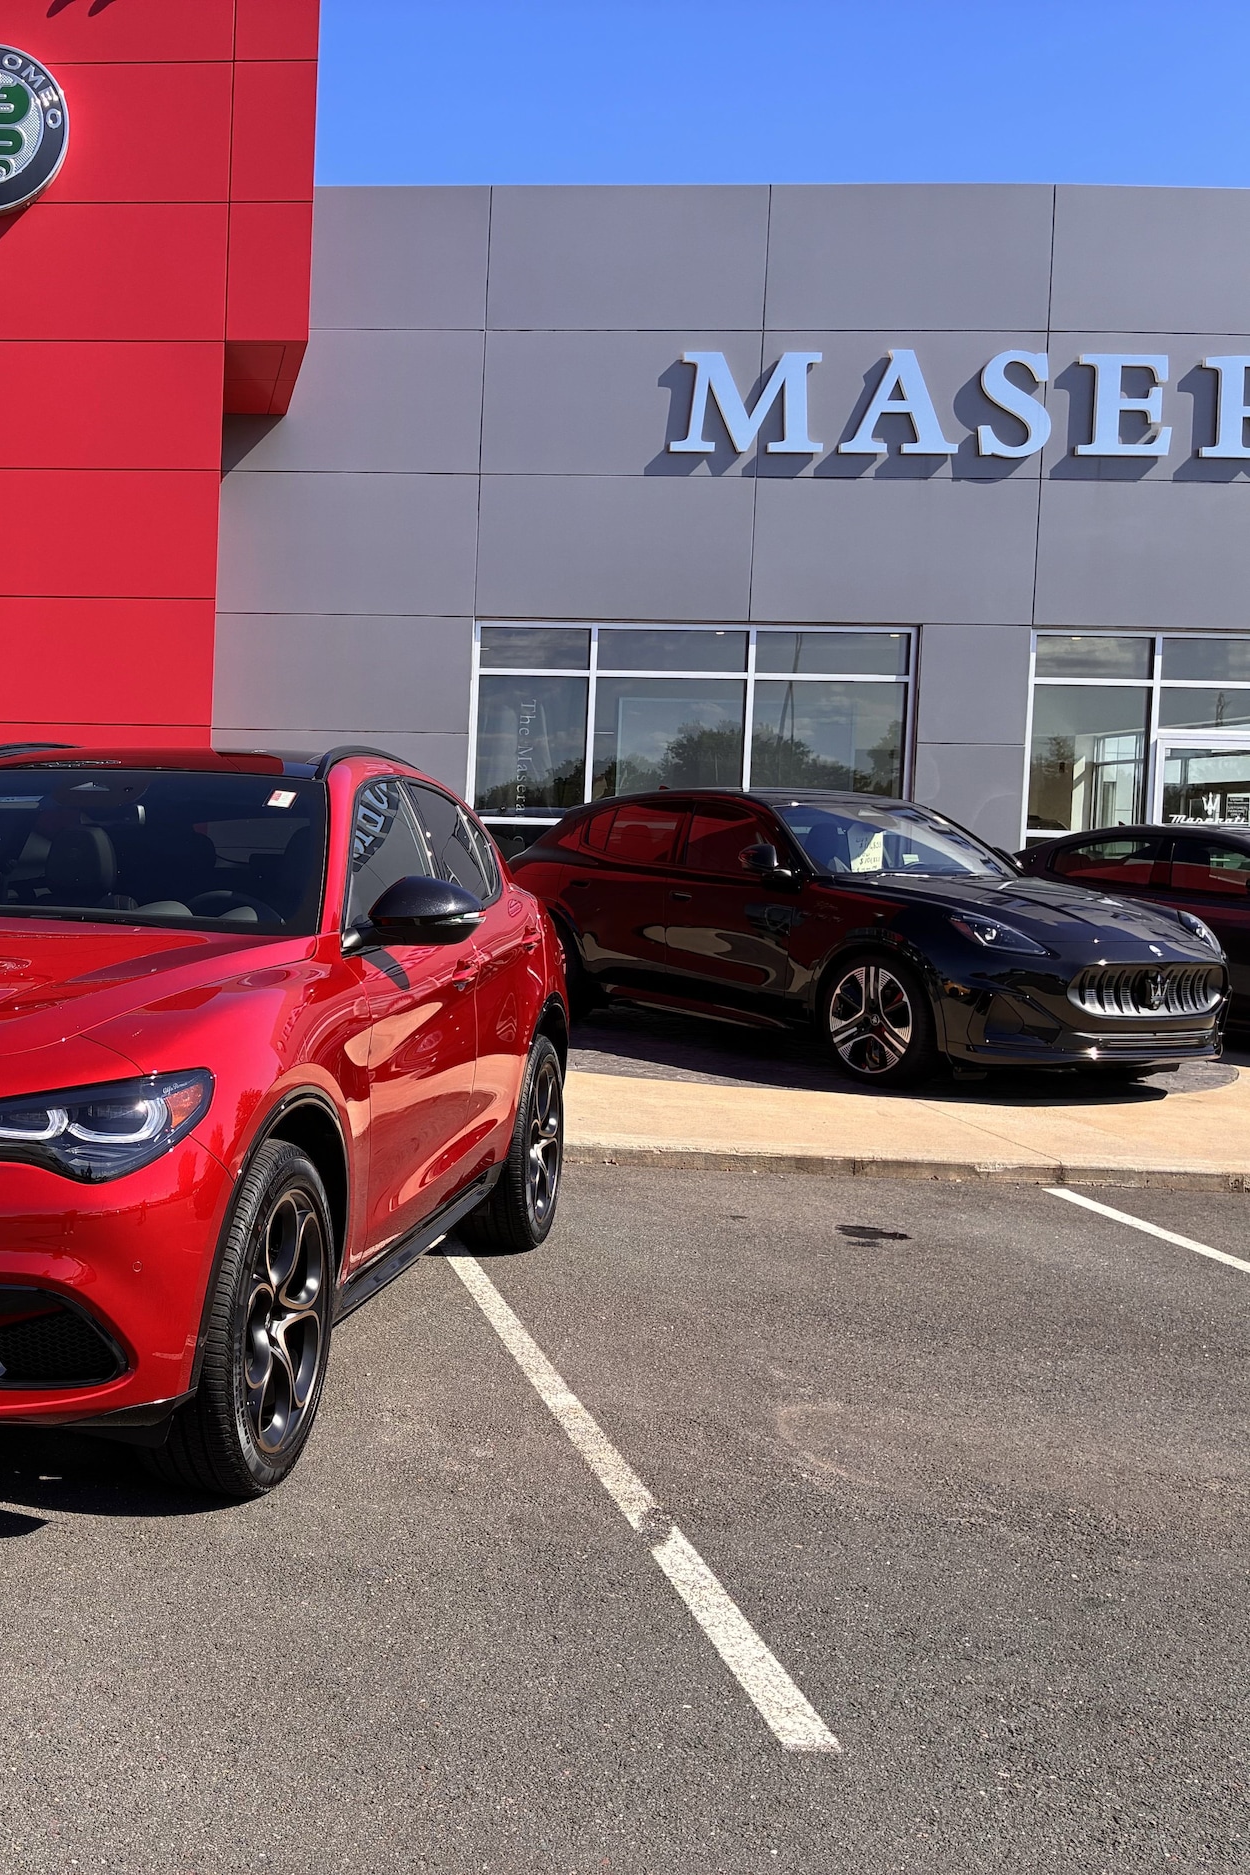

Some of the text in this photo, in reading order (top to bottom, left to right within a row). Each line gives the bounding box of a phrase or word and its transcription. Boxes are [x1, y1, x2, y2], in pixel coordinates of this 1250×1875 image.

[518, 699, 537, 736] The
[515, 745, 533, 818] Masera
[1168, 814, 1249, 825] Maserati
